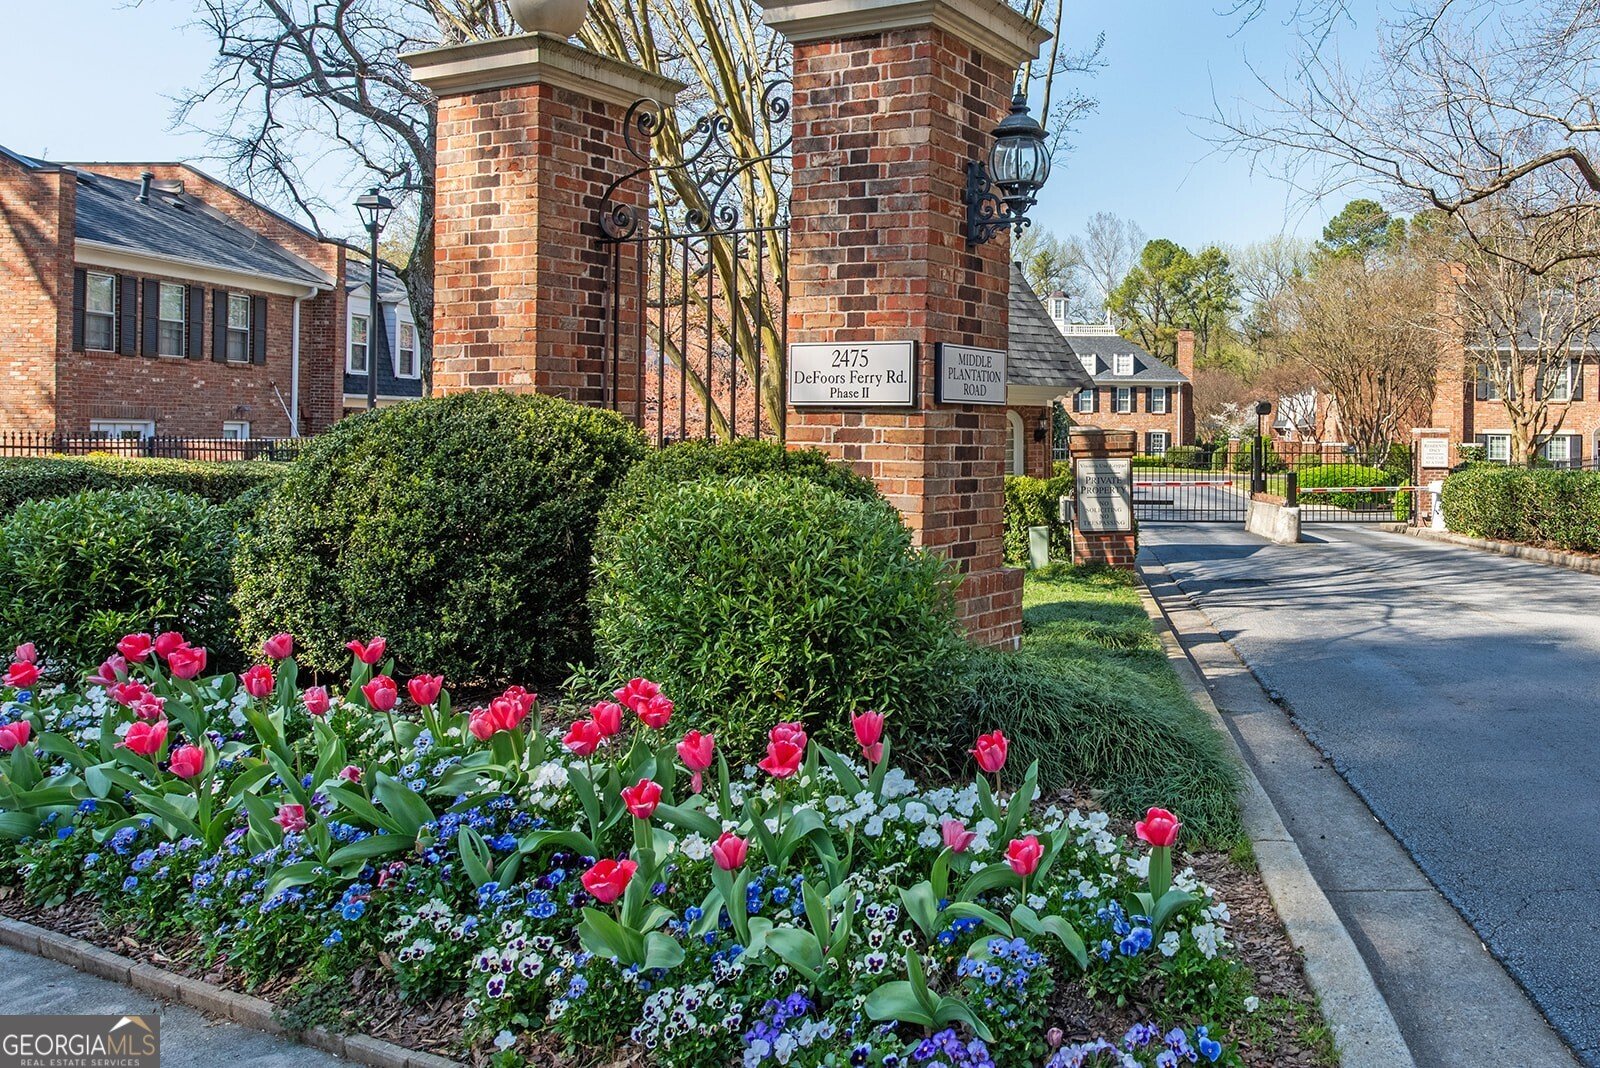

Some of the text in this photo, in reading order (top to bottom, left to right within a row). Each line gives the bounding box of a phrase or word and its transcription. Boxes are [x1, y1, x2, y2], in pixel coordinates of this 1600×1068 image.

[831, 349, 869, 368] 2475
[958, 352, 993, 369] MIDDLE
[794, 369, 907, 387] DeFoors Ferry Rd.
[948, 366, 1001, 383] PLANTATION
[829, 387, 869, 399] Phase II
[963, 383, 987, 397] ROAD
[1085, 476, 1121, 485] PRIVATE
[1081, 486, 1126, 495] PROPERTY
